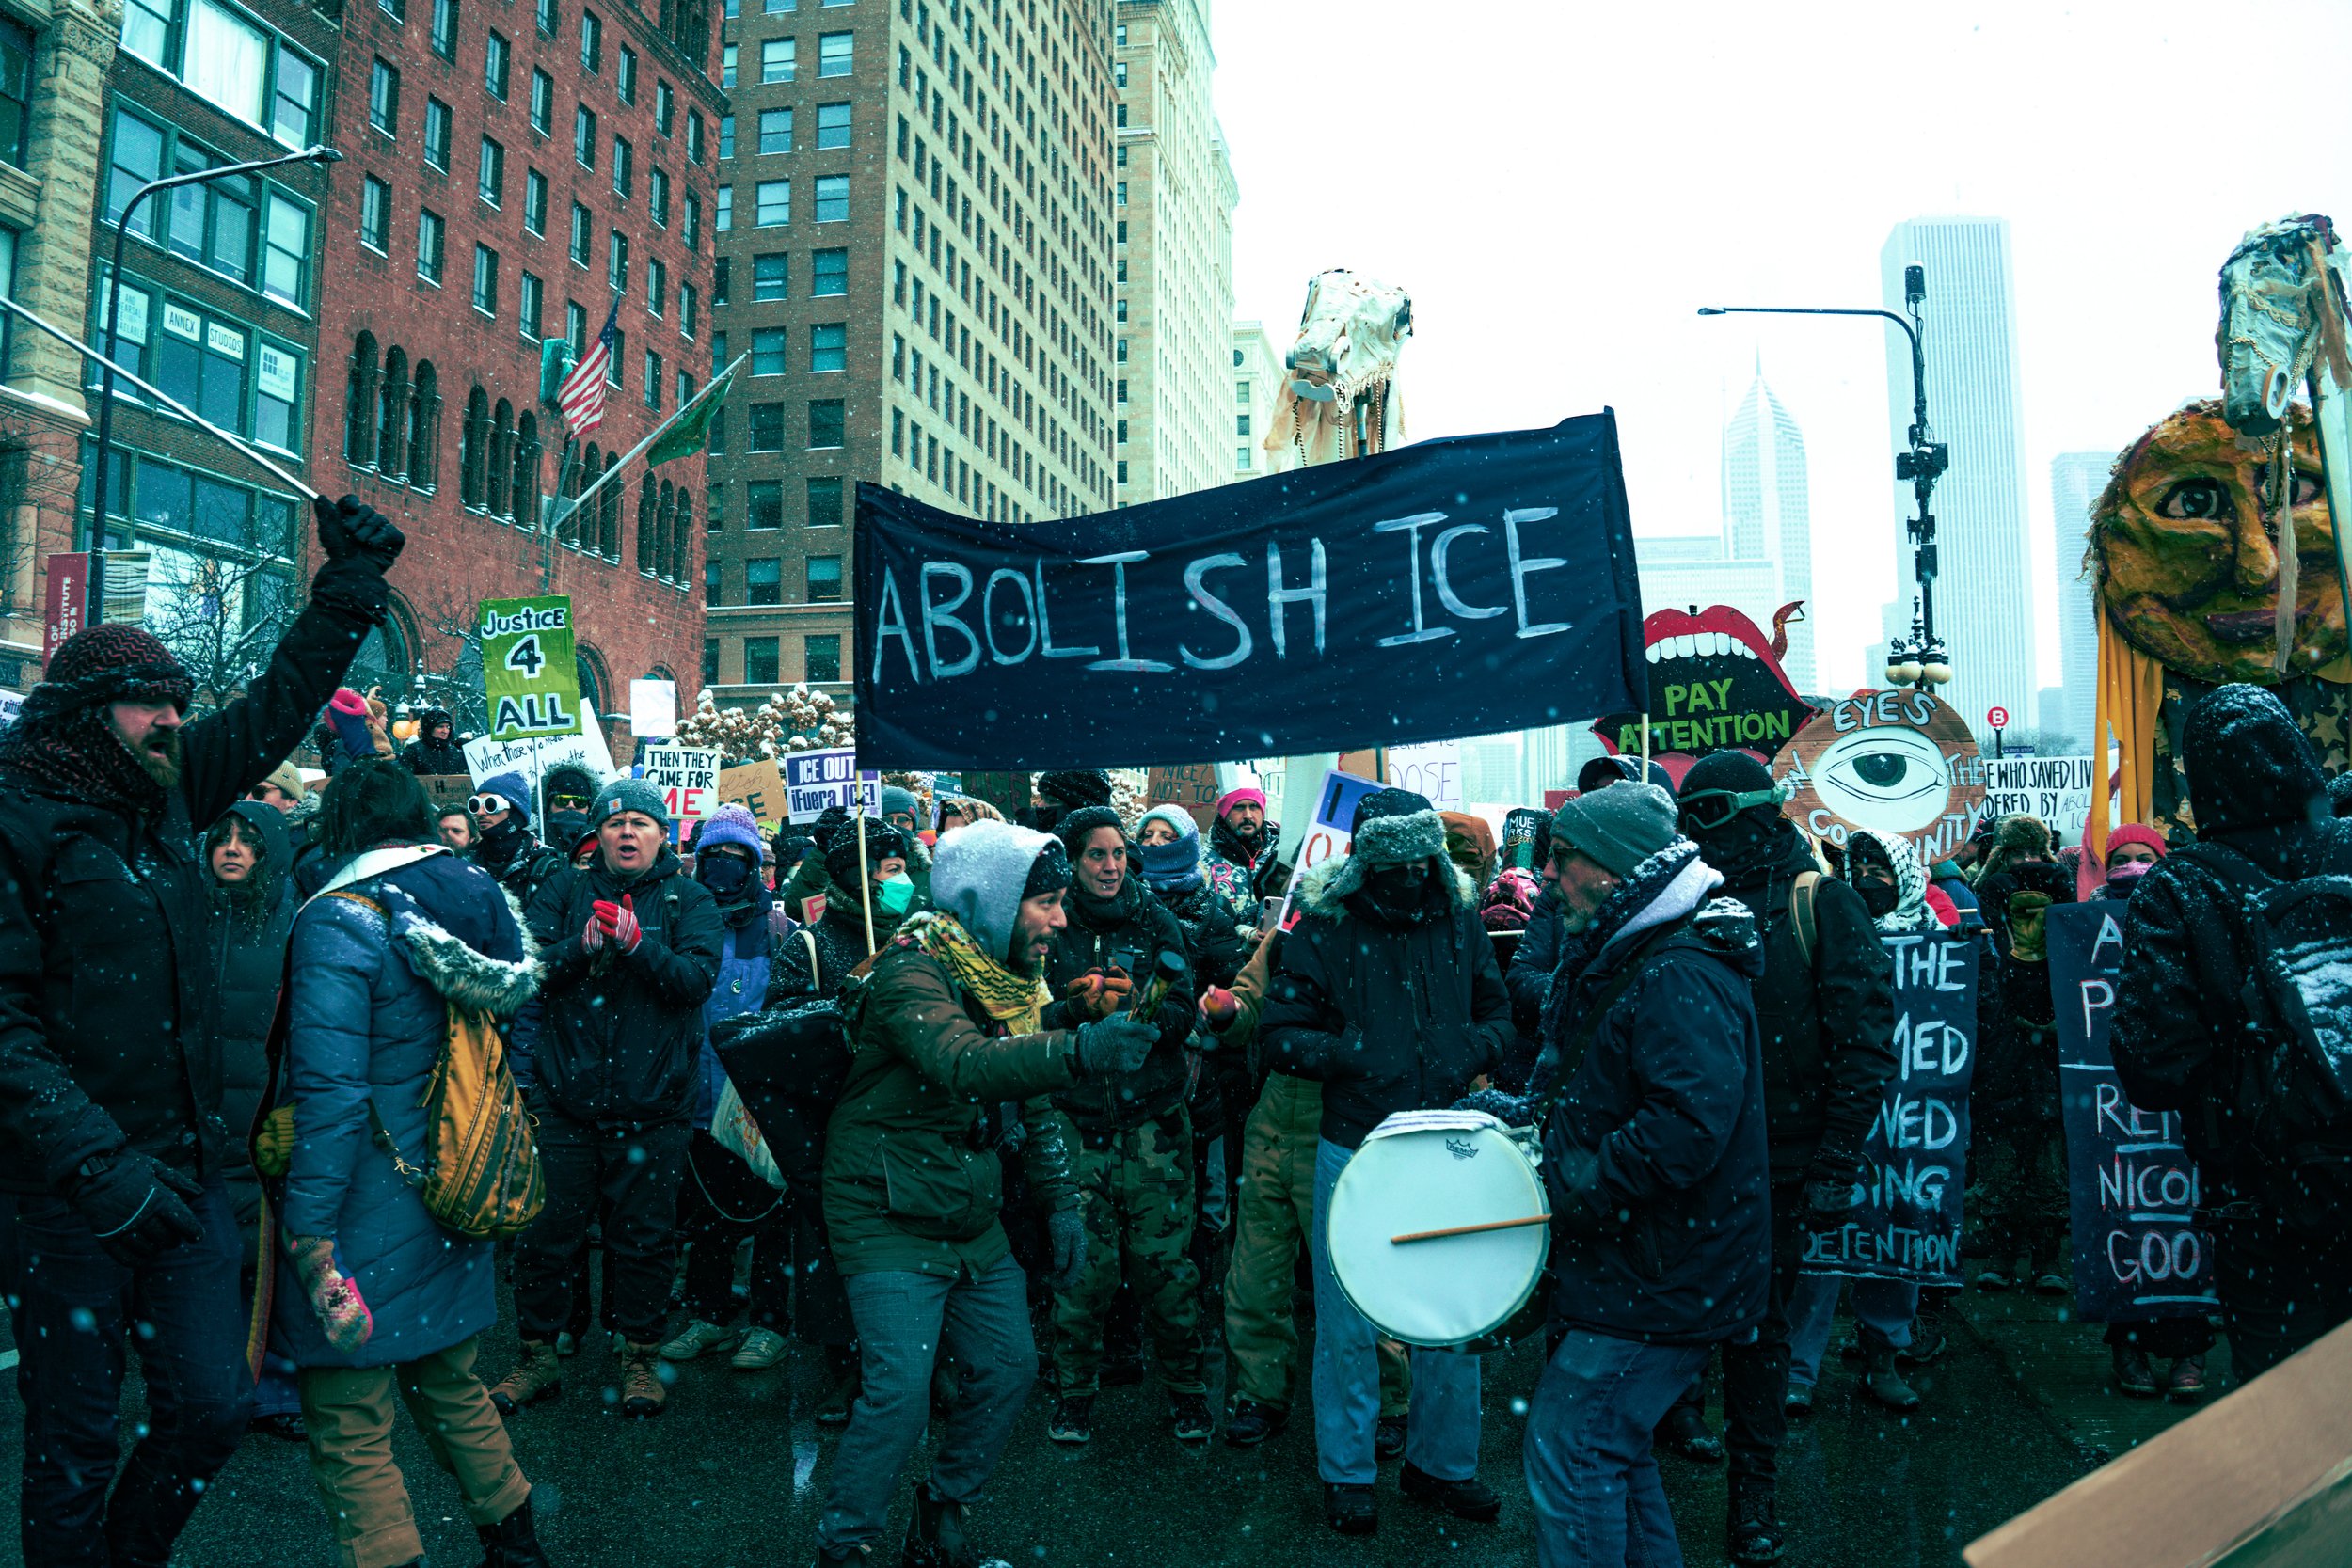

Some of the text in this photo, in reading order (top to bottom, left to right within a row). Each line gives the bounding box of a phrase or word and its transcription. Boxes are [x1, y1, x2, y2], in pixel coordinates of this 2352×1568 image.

[168, 311, 242, 353] ANNEX STUDIOS
[60, 577, 71, 639] INSTITUTE
[872, 507, 1572, 685] ABOLISH ICE
[505, 634, 545, 679] 4
[1664, 677, 1733, 716] PAY
[1833, 690, 1938, 733] EYES
[495, 693, 575, 735] ALL
[1992, 710, 2005, 724] B
[469, 745, 506, 773] When
[649, 750, 716, 768] THEN THEY
[799, 756, 856, 784] ICE OUT
[1945, 752, 1986, 786] THE
[1997, 762, 2026, 789] WHO
[2028, 760, 2071, 790] SAVED
[2072, 758, 2095, 790] LIV
[645, 768, 714, 789] CAME FOR
[842, 783, 876, 807] ICE!
[1152, 781, 1216, 804] NOT TO
[2040, 792, 2058, 817] BY
[1880, 935, 1971, 991] THE
[1449, 1143, 1475, 1157] REMO
[2106, 1229, 2201, 1284] GOO
